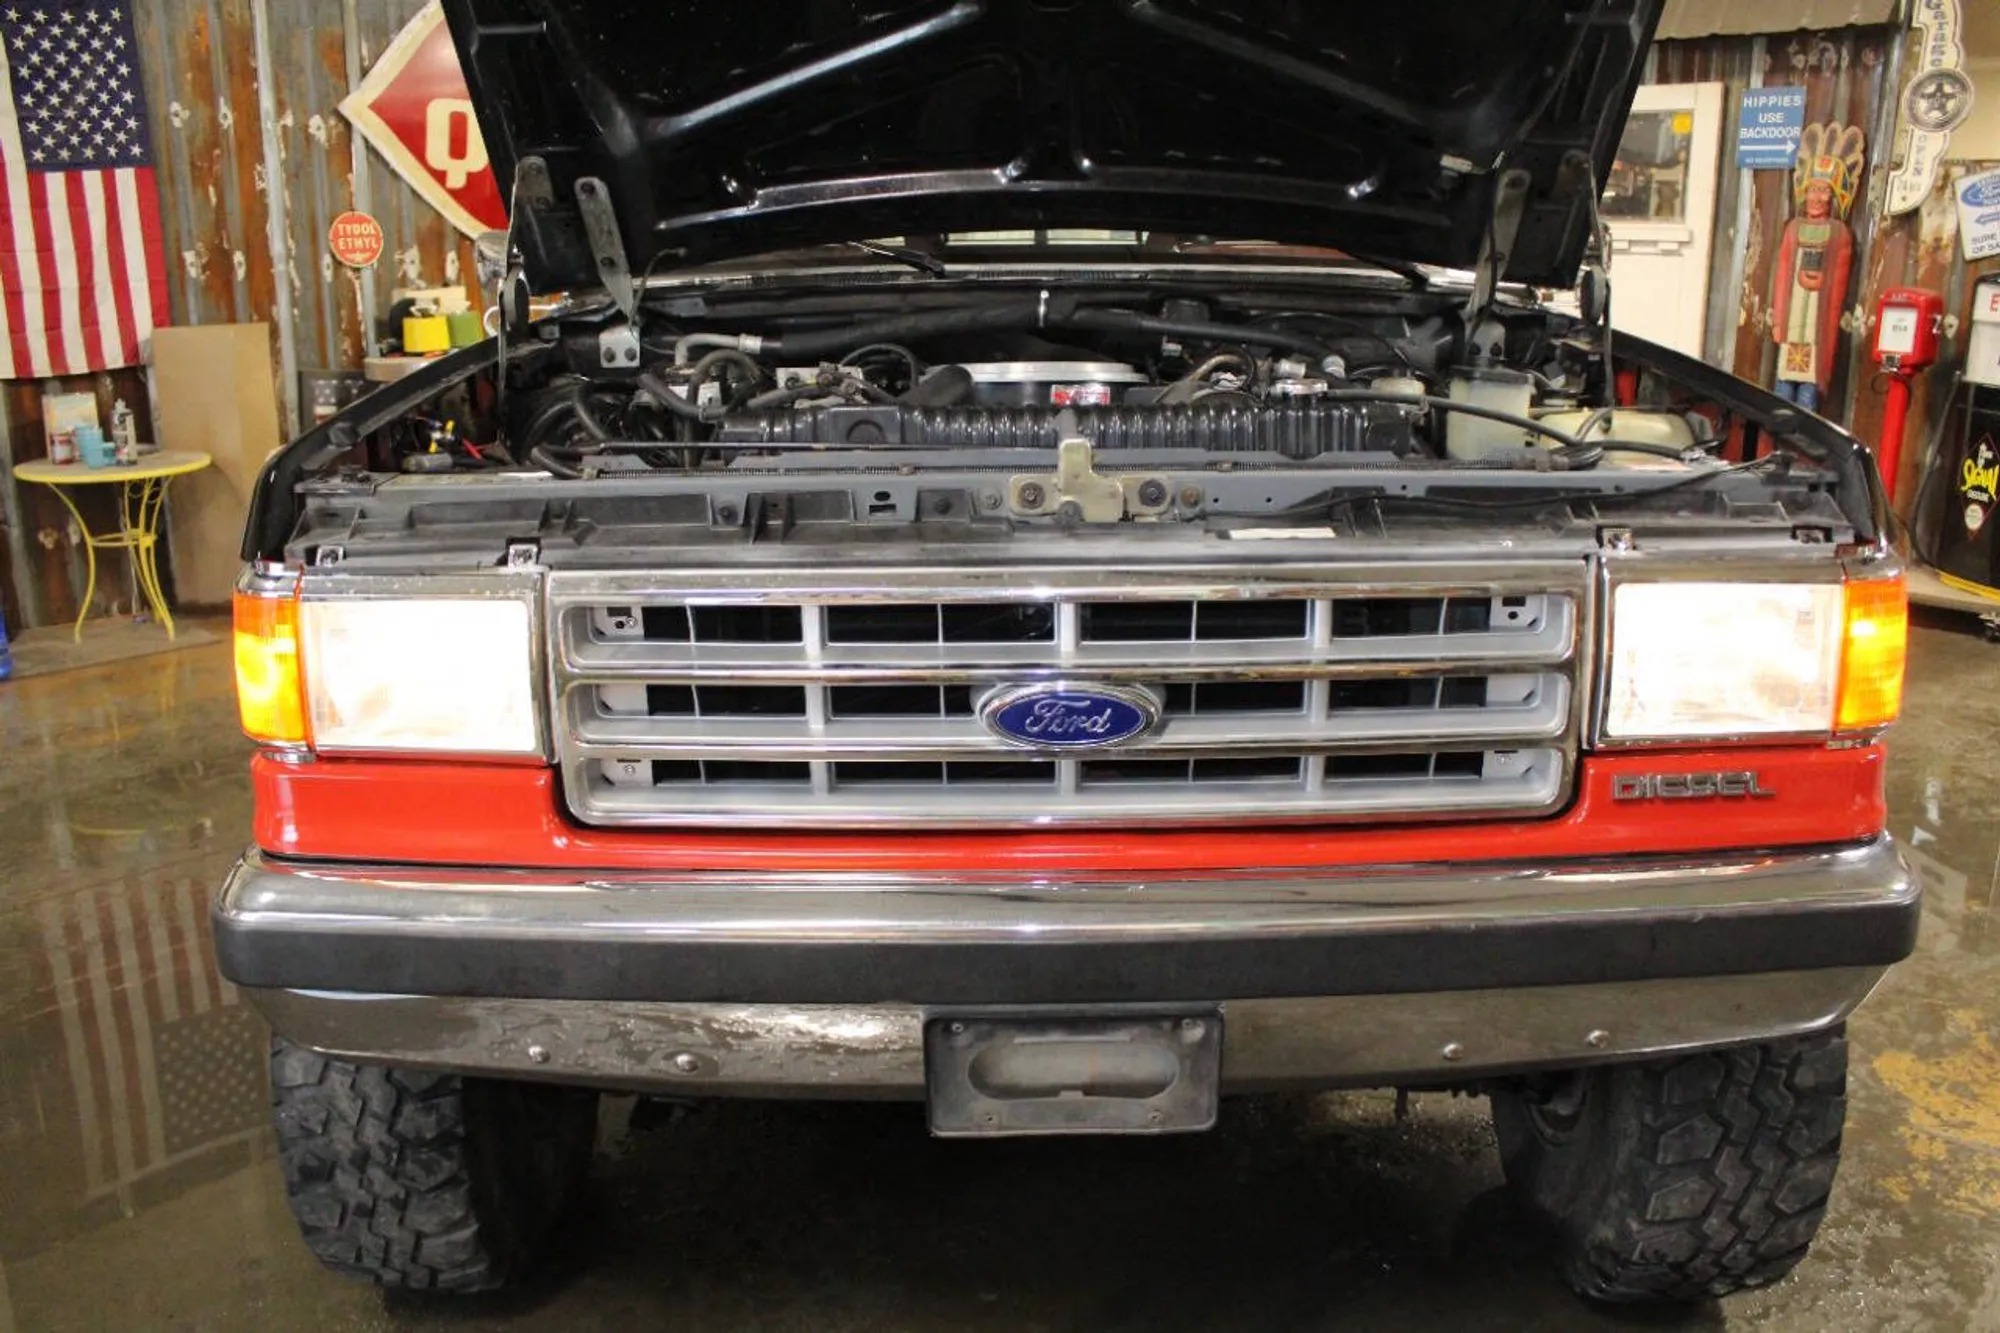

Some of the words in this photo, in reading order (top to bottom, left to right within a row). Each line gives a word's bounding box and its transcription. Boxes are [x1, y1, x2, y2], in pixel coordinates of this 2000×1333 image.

[1743, 95, 1802, 108] HIPPIES
[1759, 112, 1785, 123] USE
[1740, 127, 1801, 139] BACKDOOR
[338, 223, 376, 237] TYDOL
[338, 237, 379, 250] ETHYL
[1024, 699, 1112, 734] Ford
[1612, 772, 1776, 800] DIESEL
